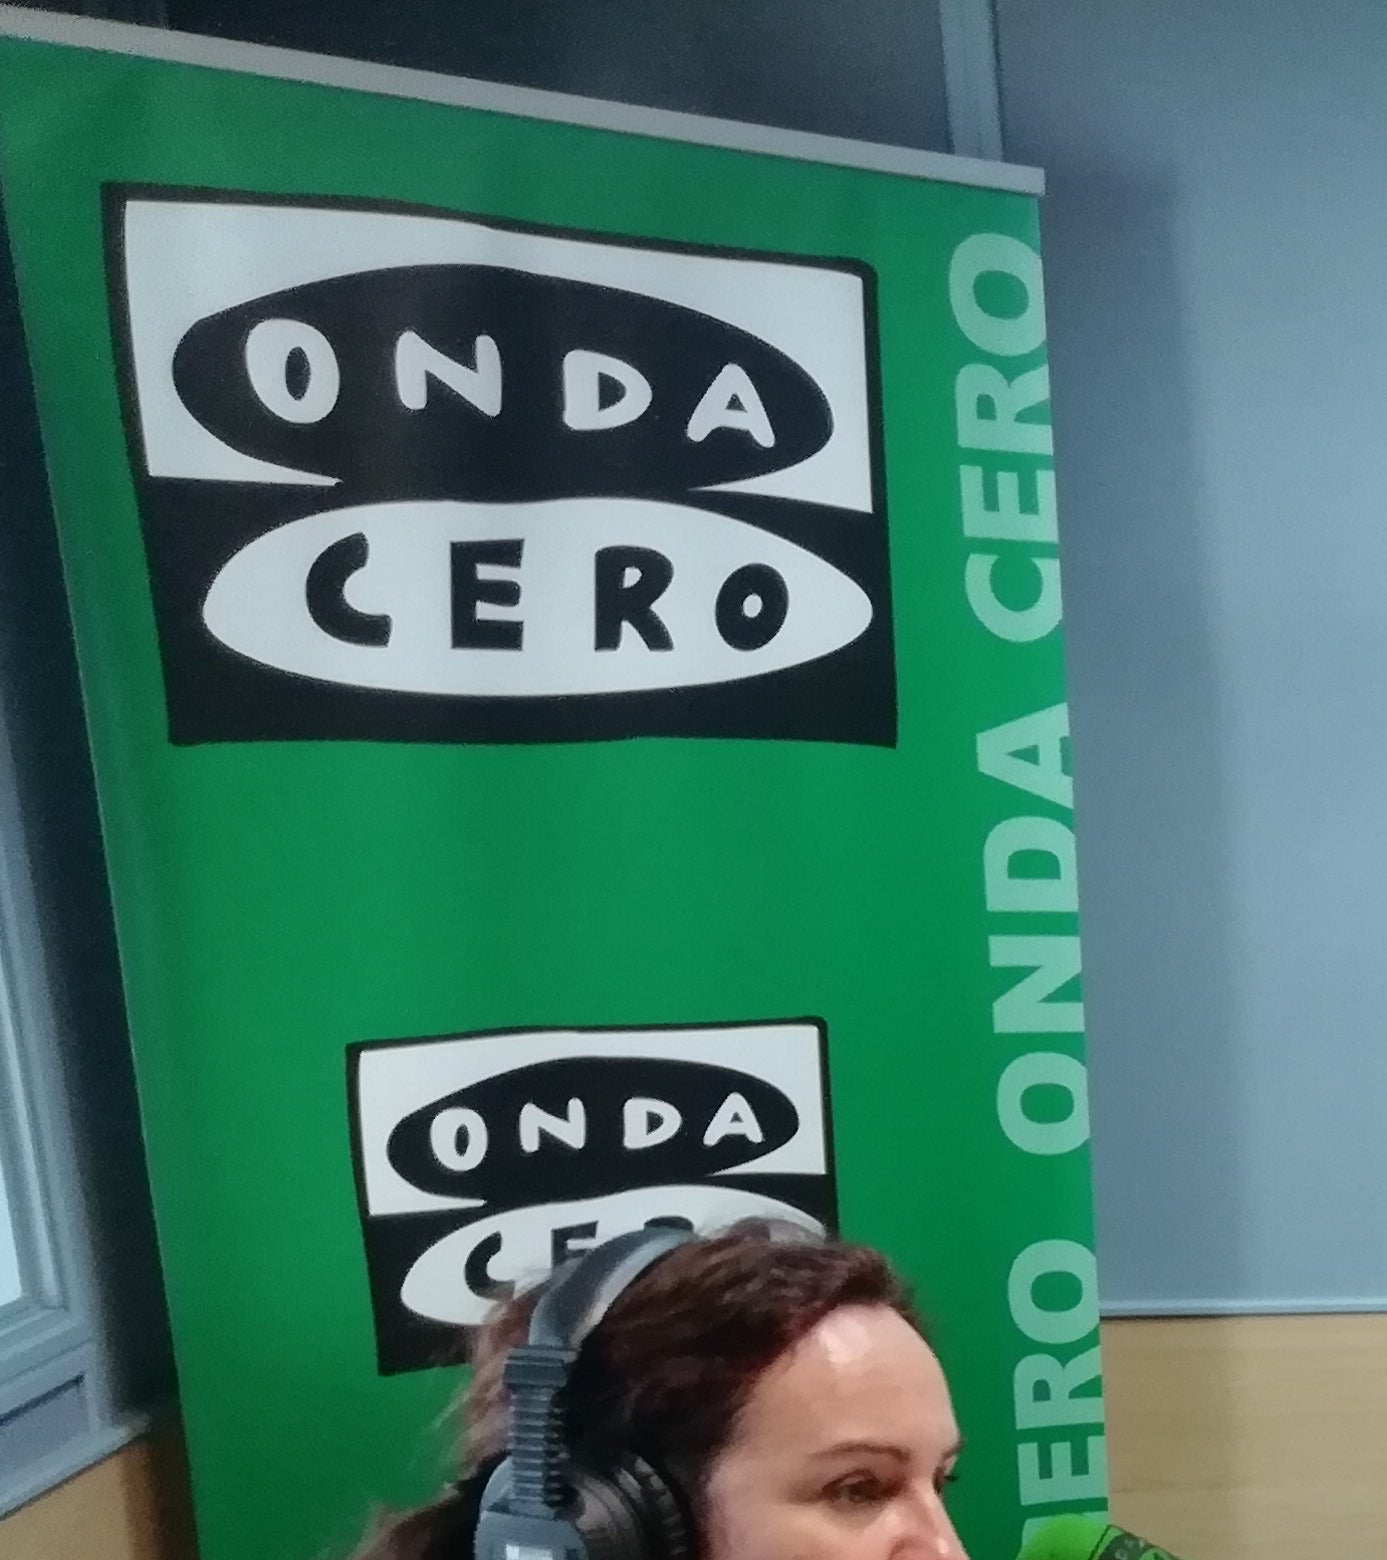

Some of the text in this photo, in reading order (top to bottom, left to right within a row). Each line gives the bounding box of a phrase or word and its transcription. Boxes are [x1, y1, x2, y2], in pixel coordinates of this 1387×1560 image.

[244, 316, 775, 448] ONDA
[948, 233, 1063, 643] CERO
[304, 531, 790, 652] CERO
[976, 702, 1091, 1156] ONDA
[430, 1092, 764, 1171] ONDA
[1007, 1238, 1109, 1546] ERO
